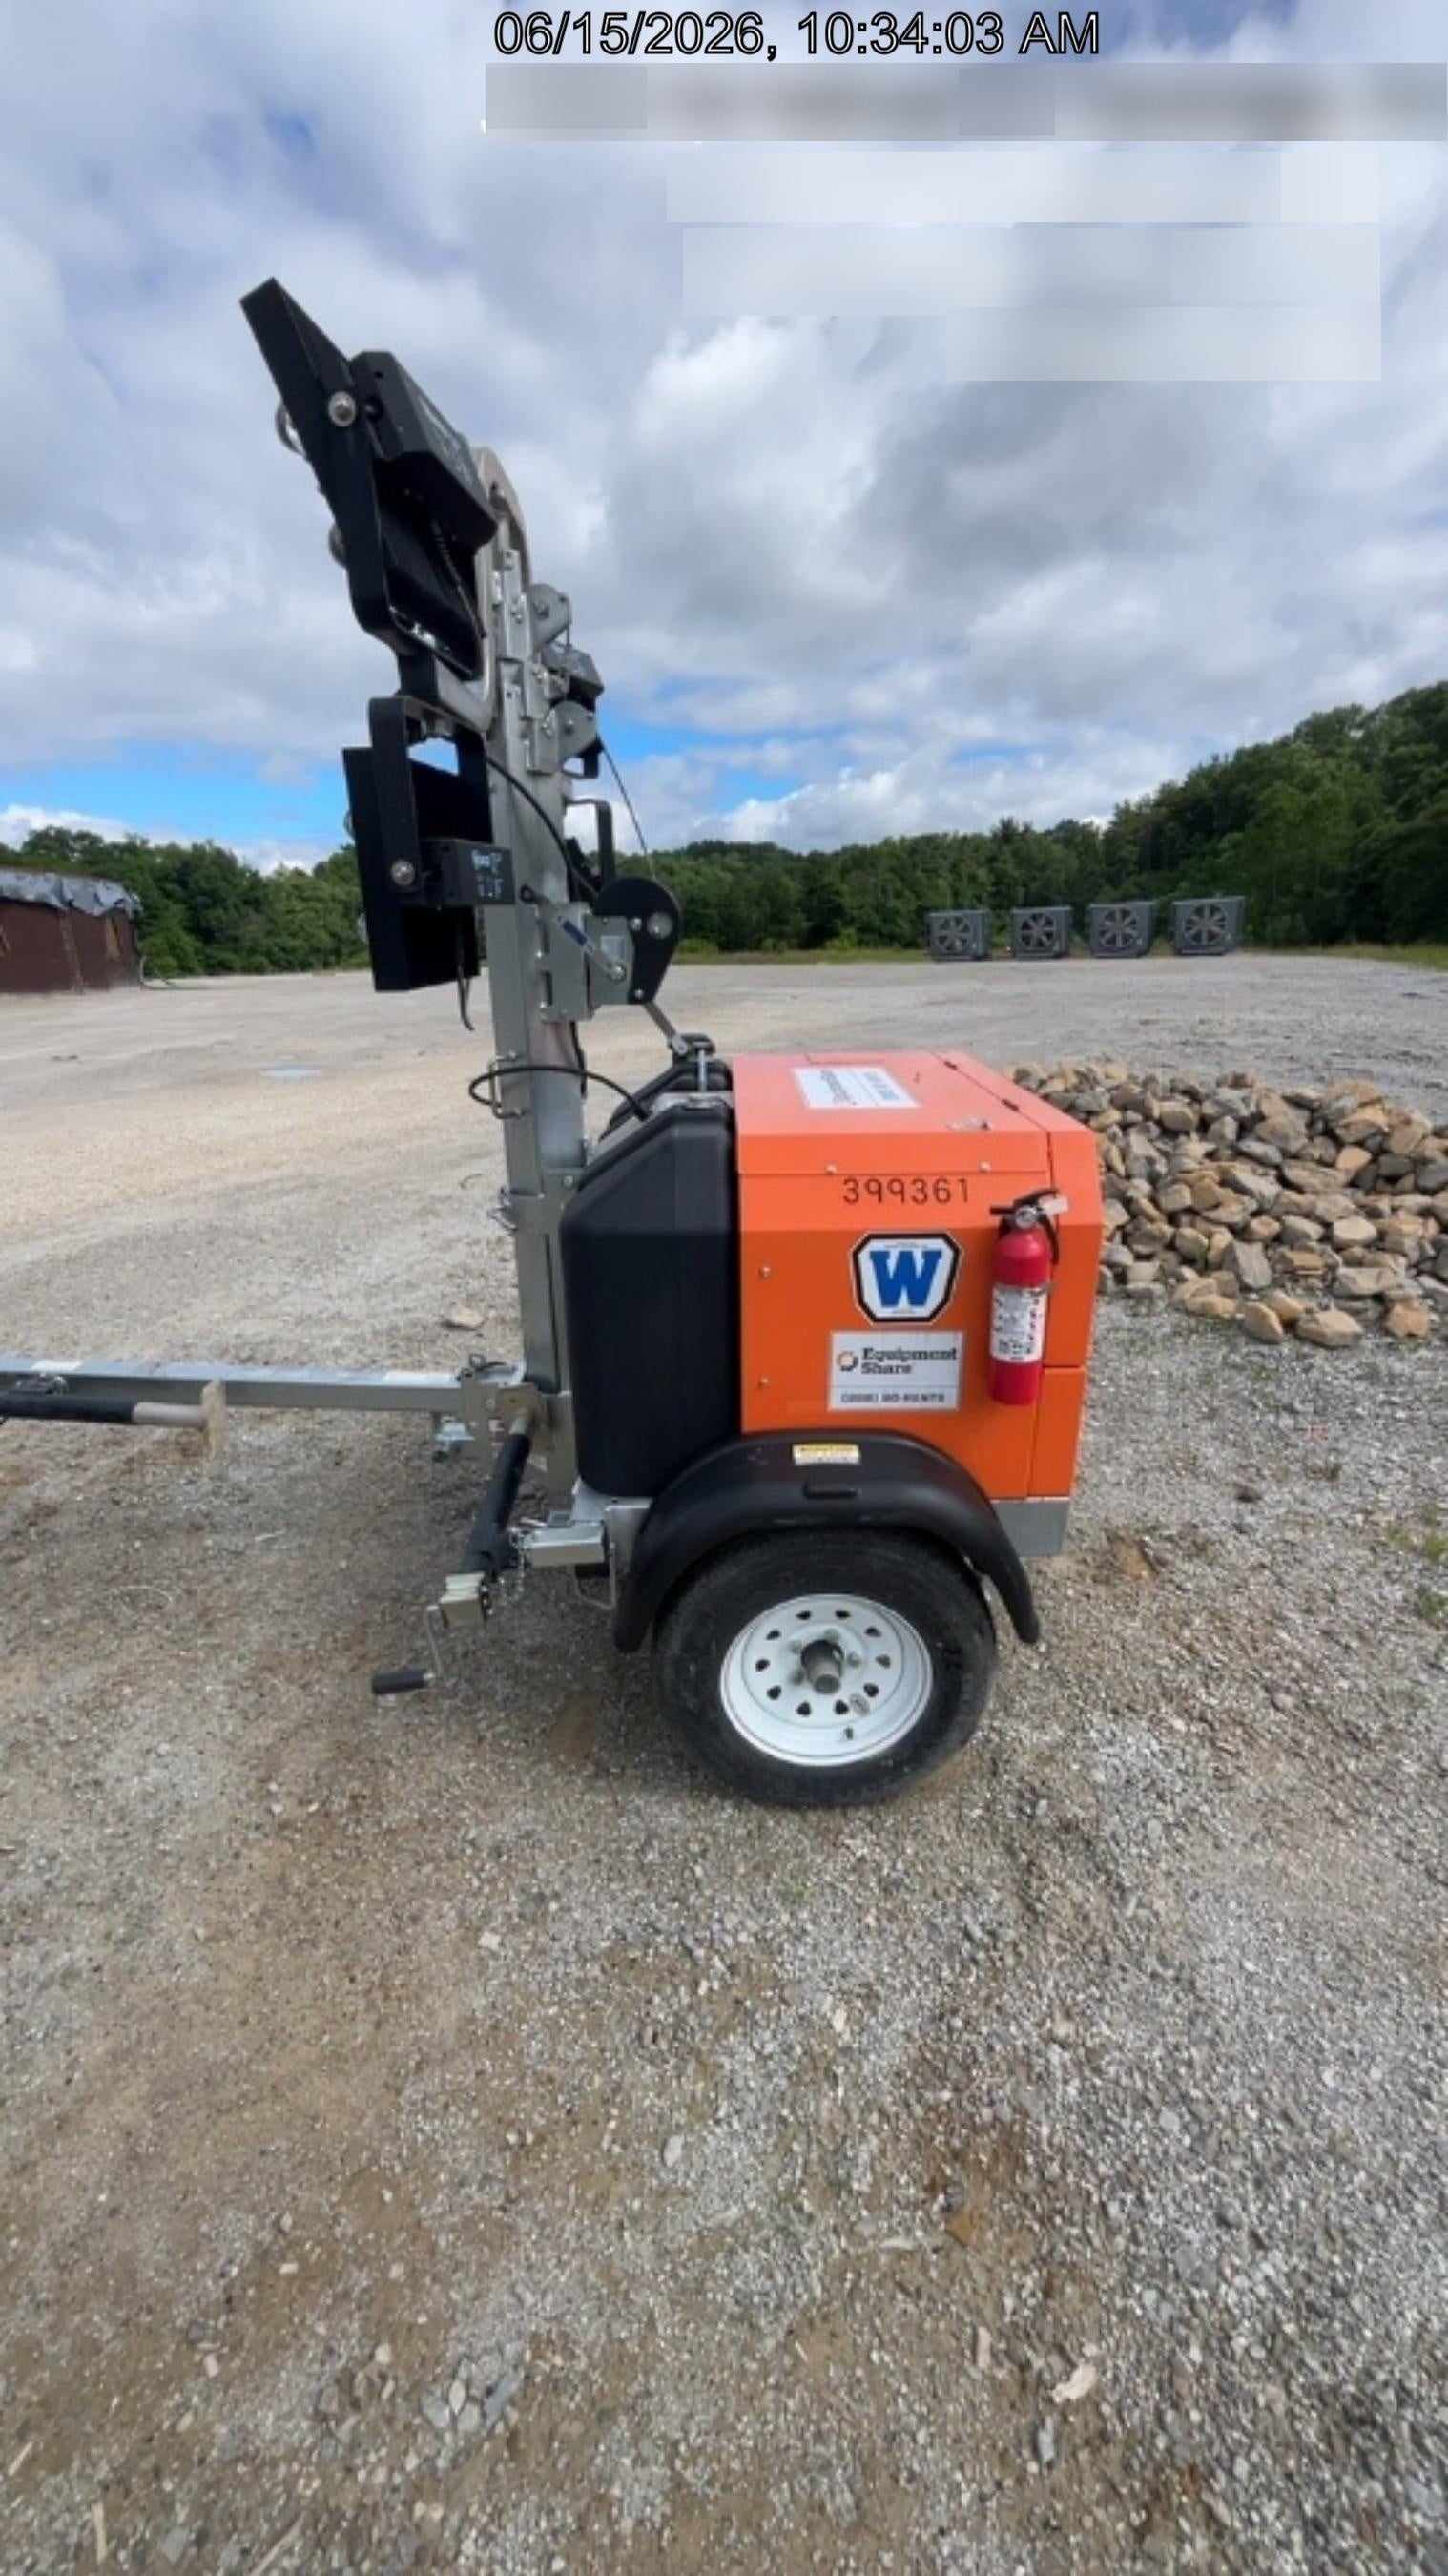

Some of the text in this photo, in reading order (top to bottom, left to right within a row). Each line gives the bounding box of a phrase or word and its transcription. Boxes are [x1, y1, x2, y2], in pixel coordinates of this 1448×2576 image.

[843, 1177, 968, 1204] 399361
[869, 1250, 942, 1307] W
[861, 1347, 957, 1361] Equipment
[861, 1362, 912, 1374] Share
